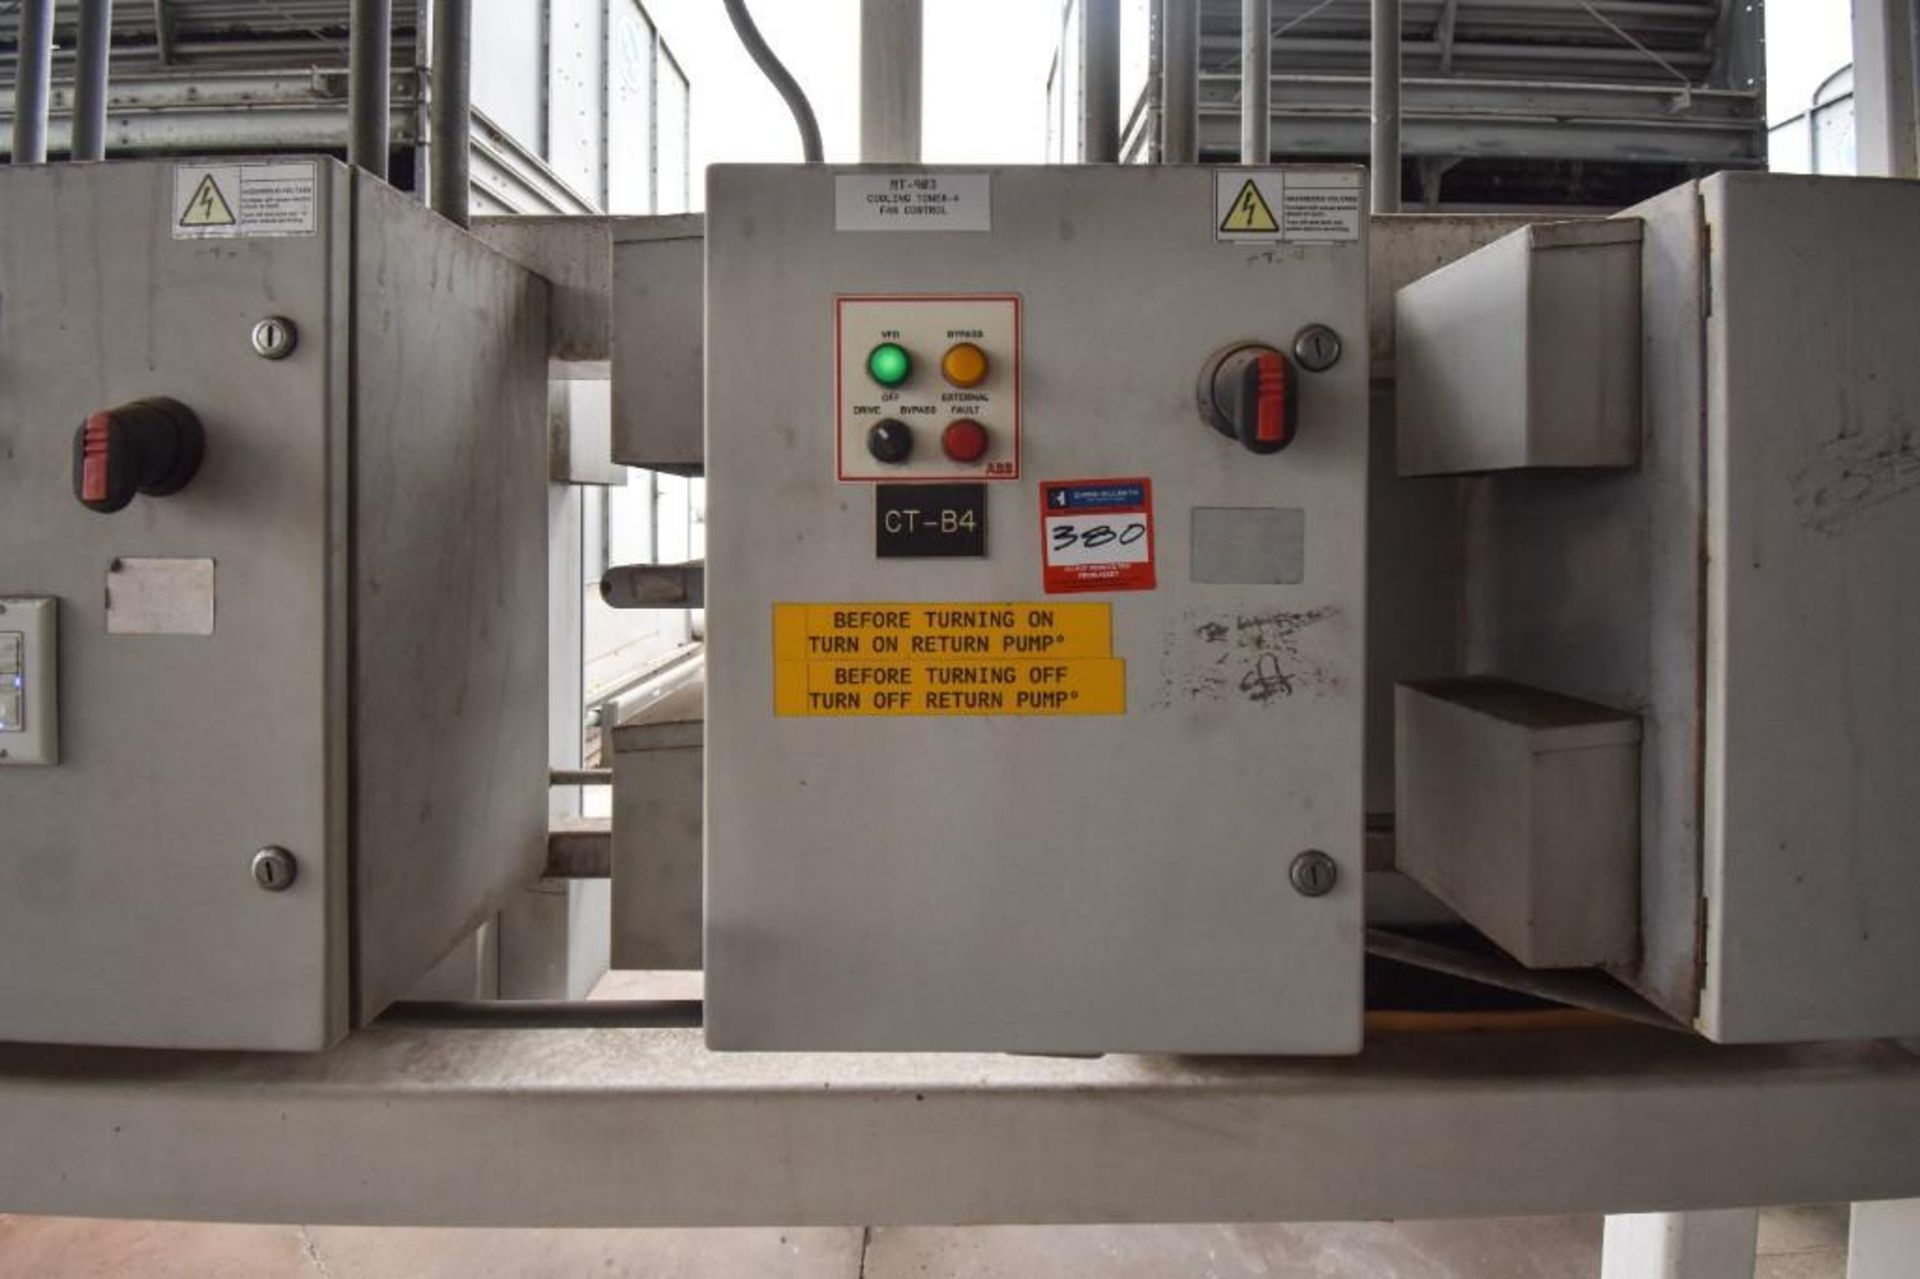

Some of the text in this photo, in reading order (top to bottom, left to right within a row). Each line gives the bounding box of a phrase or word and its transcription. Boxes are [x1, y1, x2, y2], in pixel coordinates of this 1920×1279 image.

[947, 330, 984, 339] BYPASS
[881, 393, 900, 402] OFF
[941, 392, 990, 402] EXTERNAL
[853, 406, 882, 415] DRIVE
[900, 406, 937, 415] BYPASS
[951, 405, 980, 415] FAULT
[986, 462, 1014, 475] ABB
[884, 509, 977, 534] CT-B4
[1051, 522, 1146, 552] 380
[833, 610, 1055, 629] BEFORE TURNING ON
[808, 635, 860, 653] TURN
[872, 635, 899, 653] ON
[911, 635, 990, 653] RETURN
[834, 666, 1068, 685] BEFORE TURNING OFF
[809, 692, 861, 709] TURN
[873, 692, 913, 709] OFF
[925, 692, 1003, 709] RETURN
